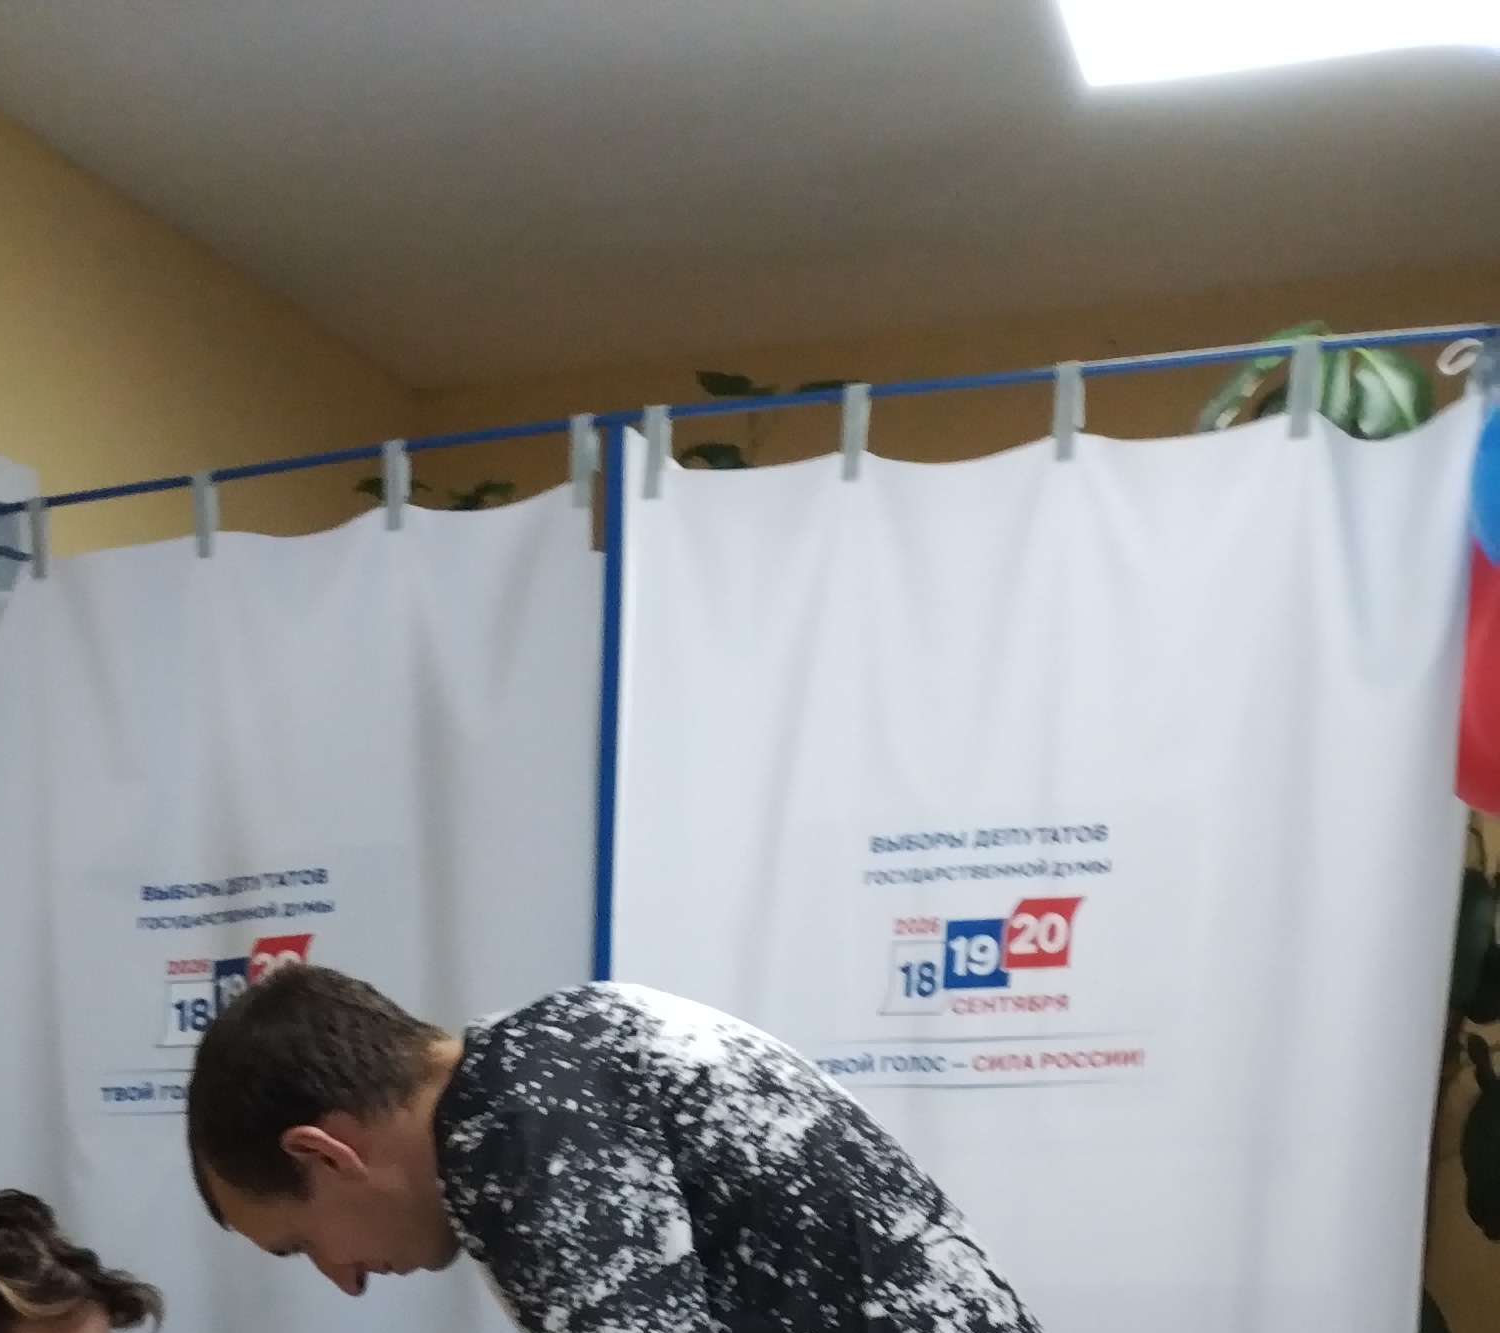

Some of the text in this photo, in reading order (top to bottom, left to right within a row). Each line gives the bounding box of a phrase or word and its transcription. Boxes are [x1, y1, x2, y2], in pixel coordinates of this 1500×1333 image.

[868, 823, 1109, 854] ВЫБОРЫ ДЕПУТАТОВ
[1008, 912, 1068, 955] 20
[949, 935, 999, 977] 19
[899, 961, 937, 998] 18
[173, 998, 209, 1032] 18
[951, 995, 1069, 1015] СЕНТЯБРЯ
[972, 1054, 1033, 1072] СИЛА
[1039, 1049, 1146, 1070] РОССИИ!
